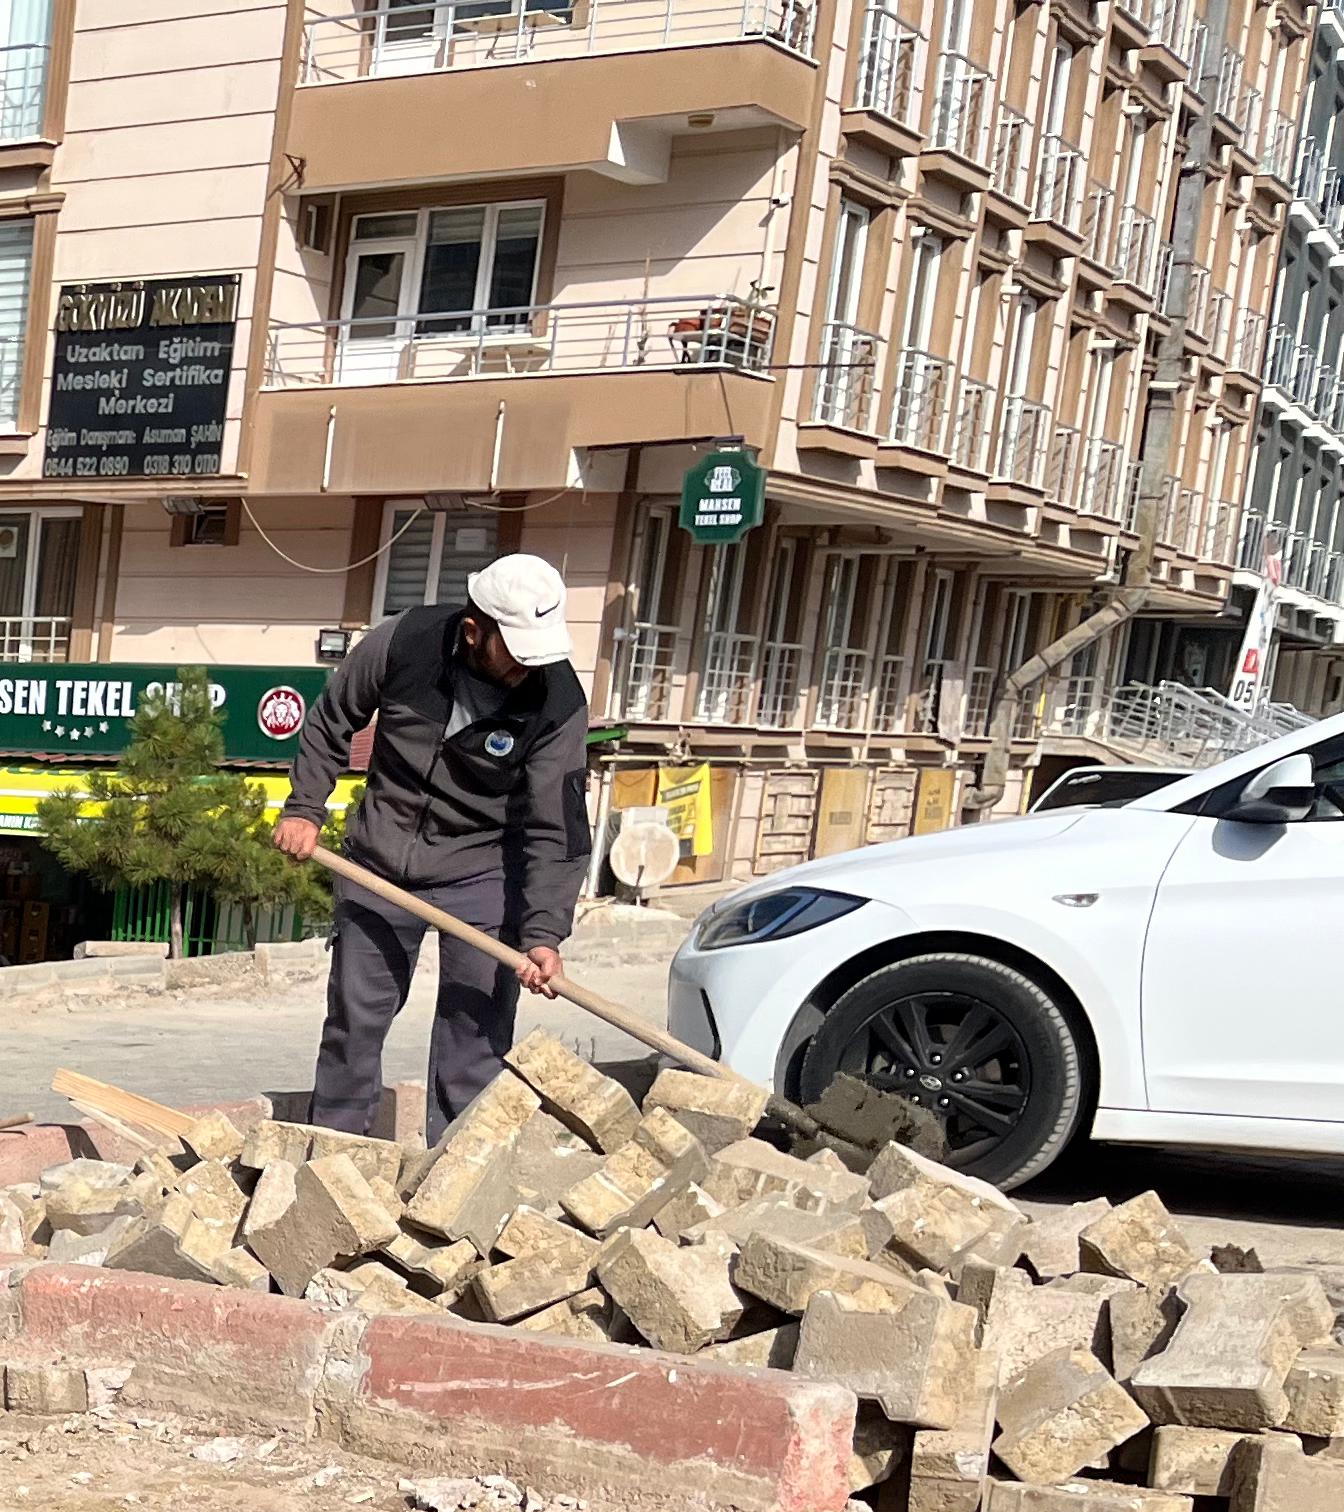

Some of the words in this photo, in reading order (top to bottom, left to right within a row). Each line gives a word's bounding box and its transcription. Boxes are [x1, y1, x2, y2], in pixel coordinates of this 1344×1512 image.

[66, 343, 145, 363] Uzaktan
[158, 336, 222, 365] Eğitim
[56, 368, 129, 391] Mesleki
[142, 364, 224, 387] Sertifika
[98, 393, 175, 415] Merkezi
[142, 426, 186, 444] Asuman
[76, 457, 98, 476] 522
[55, 680, 136, 718] TEKEL
